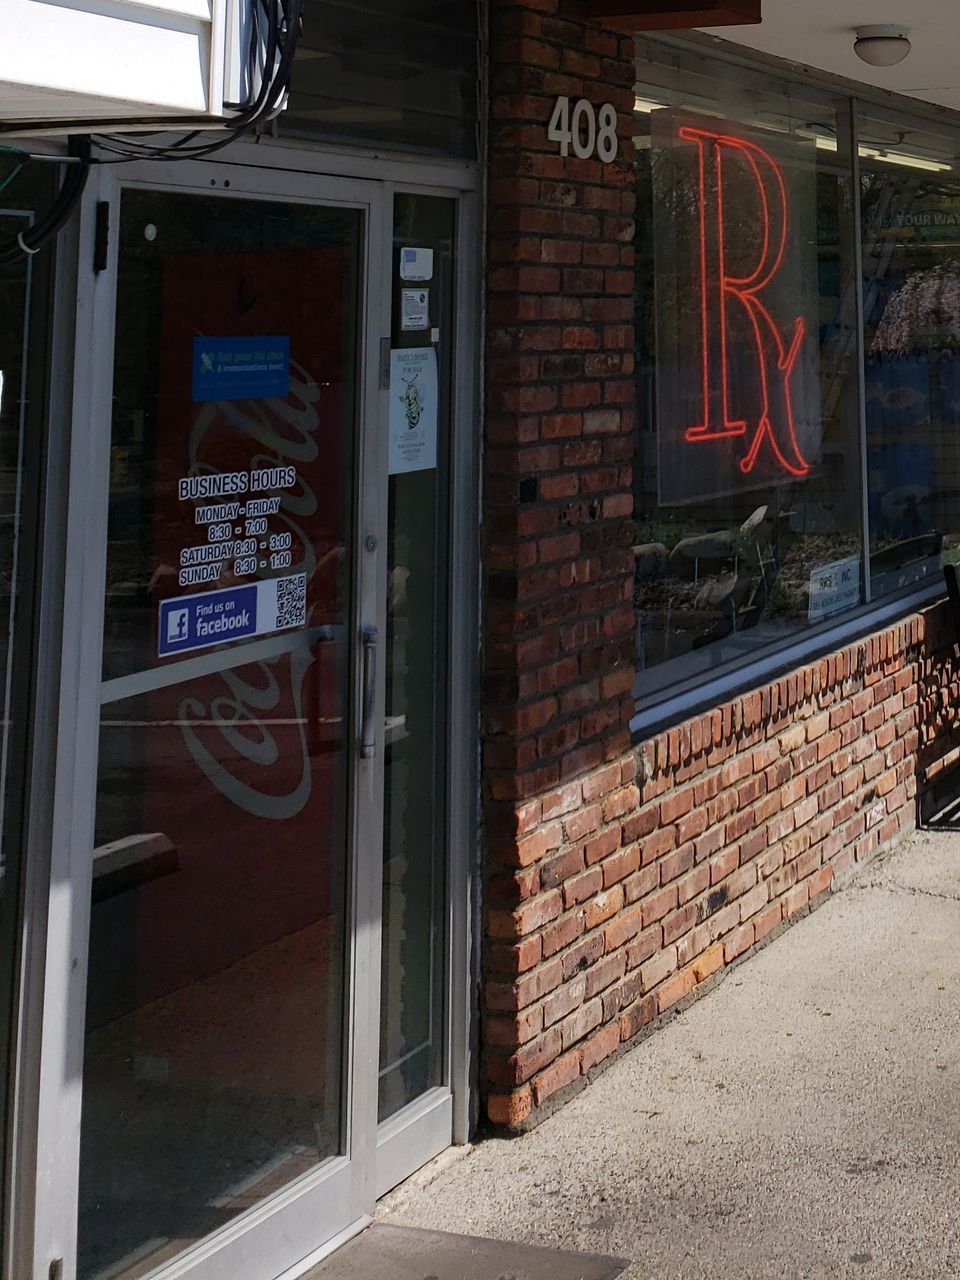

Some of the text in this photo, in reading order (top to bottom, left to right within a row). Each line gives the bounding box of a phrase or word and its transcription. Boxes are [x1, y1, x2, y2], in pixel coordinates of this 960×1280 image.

[548, 96, 618, 163] 408
[898, 213, 932, 226] YOUR
[179, 466, 296, 500] BUSINESS HOURS
[195, 502, 240, 524] MONDAY
[246, 497, 281, 517] FRIDAY
[208, 523, 232, 542] 8:30
[245, 518, 267, 536] 7:00
[181, 541, 235, 566] SATURDAY
[234, 538, 257, 556] 8:30
[269, 532, 292, 550] 3:00
[179, 563, 222, 586] SUNDAY
[234, 557, 257, 576] 8:30
[270, 552, 292, 569] 1:00
[196, 600, 235, 617] Find us on
[196, 609, 250, 637] facebook
